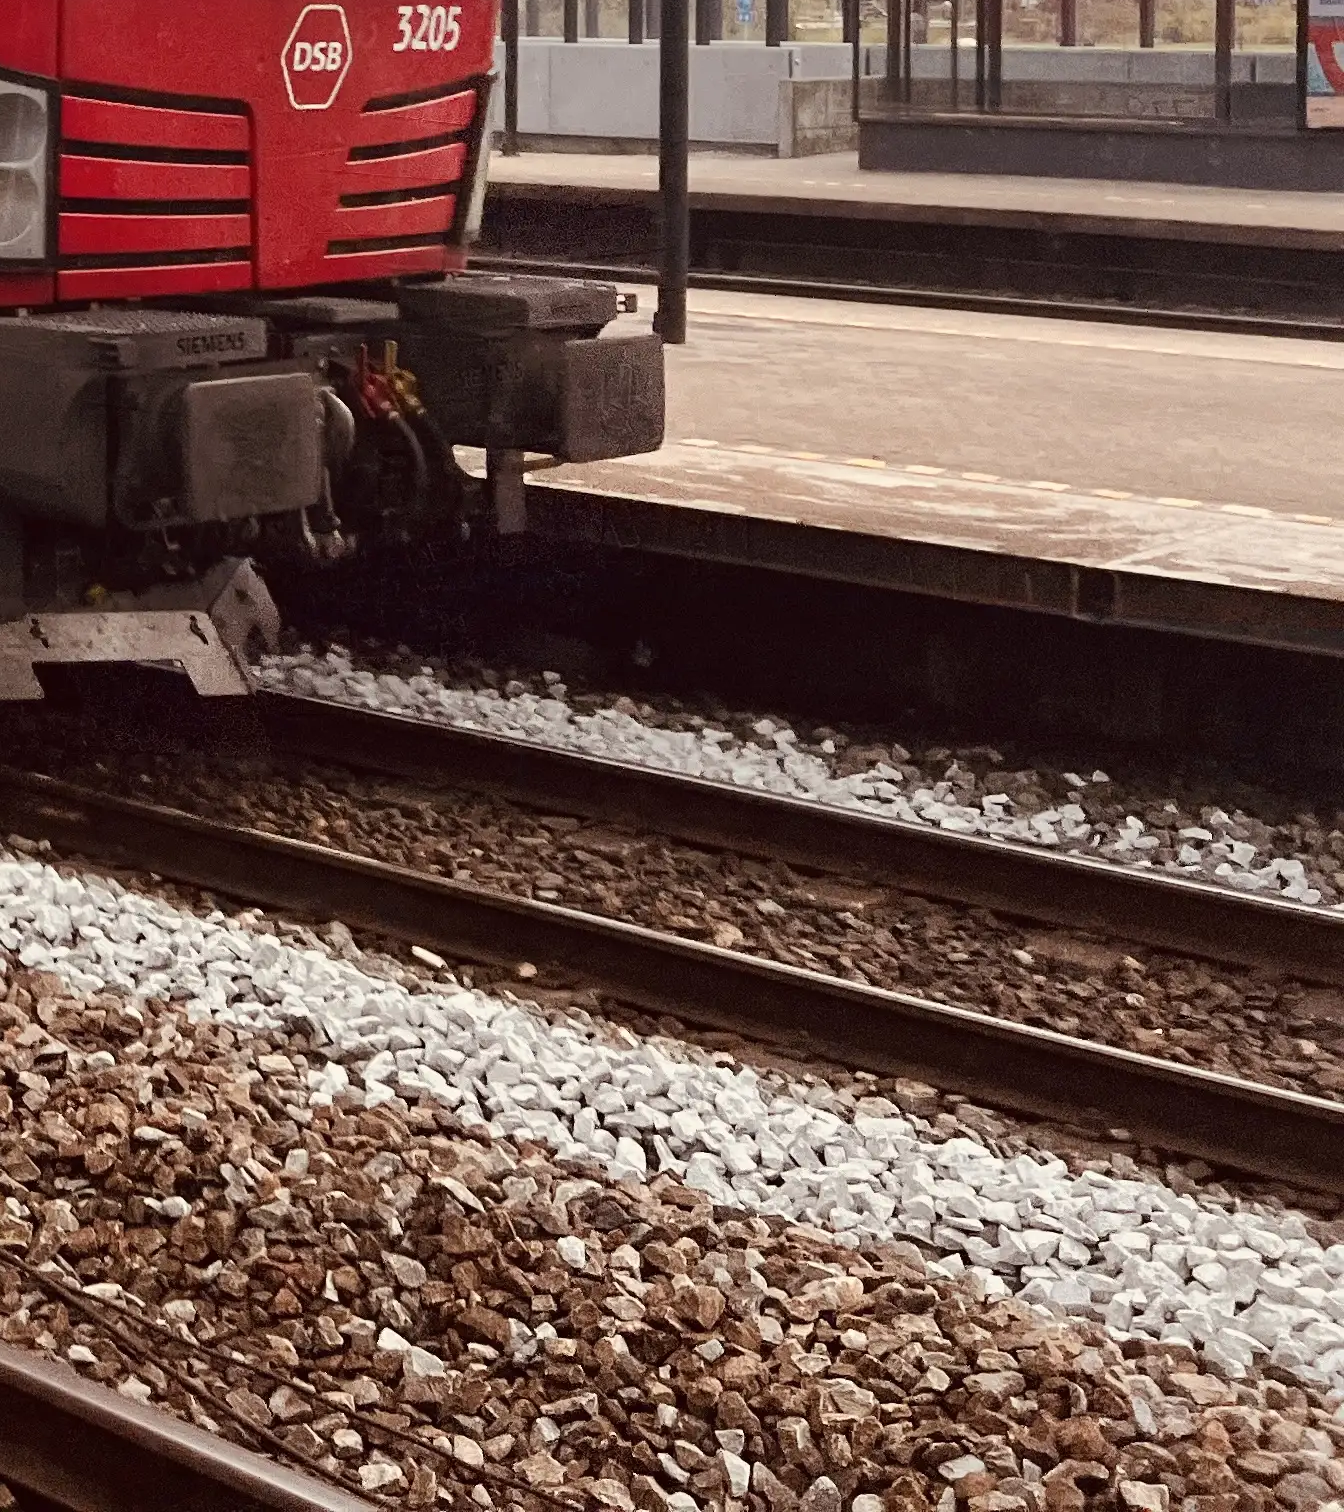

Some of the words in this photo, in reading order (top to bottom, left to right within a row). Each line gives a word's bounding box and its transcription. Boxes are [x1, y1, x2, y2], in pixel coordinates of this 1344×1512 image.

[393, 4, 462, 52] 3205
[293, 41, 343, 72] DSB
[175, 332, 246, 355] SIEMENS
